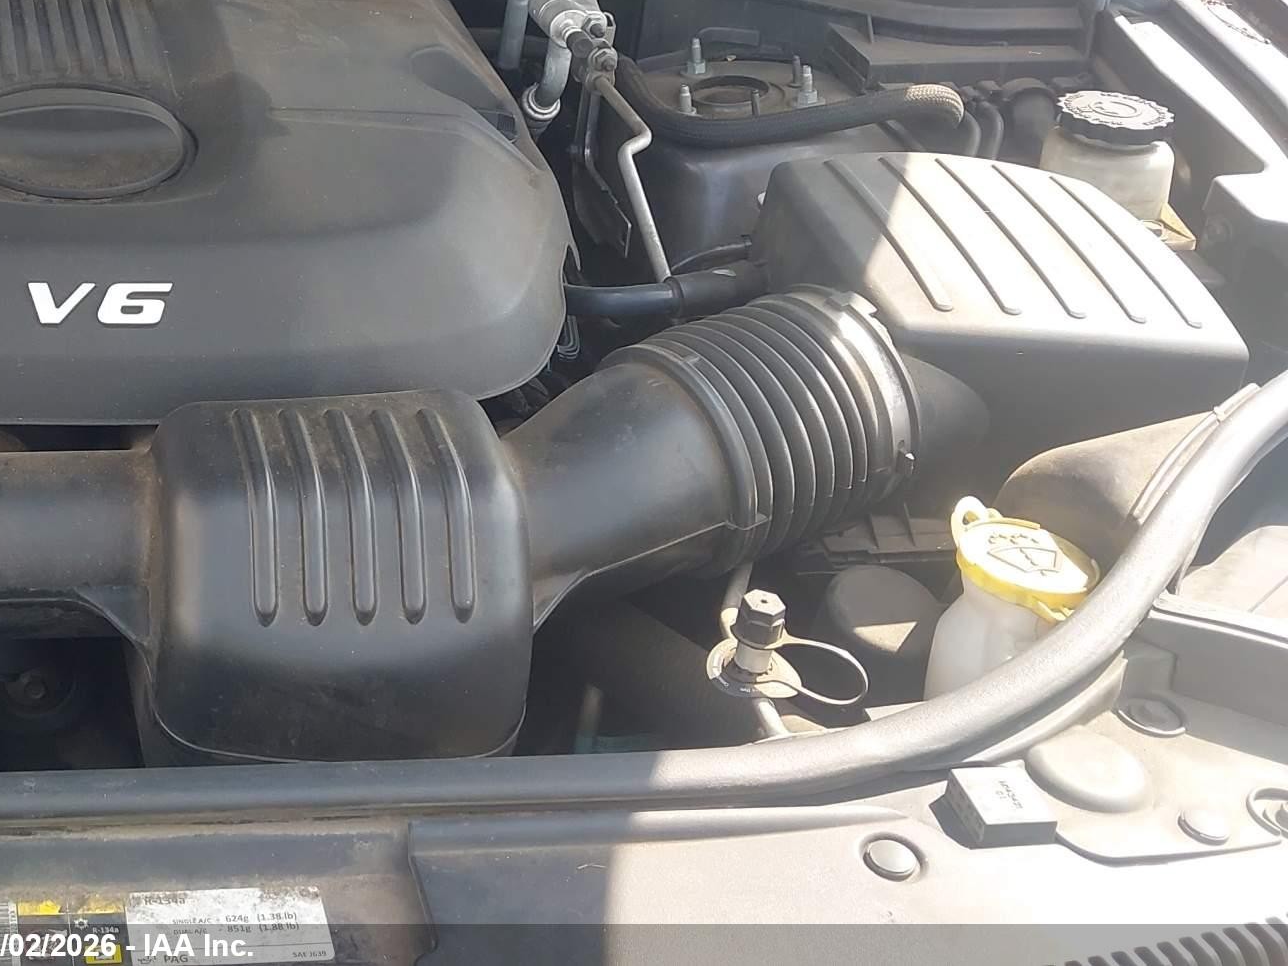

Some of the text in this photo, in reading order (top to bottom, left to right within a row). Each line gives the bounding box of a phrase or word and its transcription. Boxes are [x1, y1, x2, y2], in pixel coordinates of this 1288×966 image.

[27, 282, 173, 325] V6
[225, 914, 249, 924] 624g
[92, 926, 119, 934] R-134a
[227, 924, 252, 934] 851g
[164, 954, 189, 963] PAG
